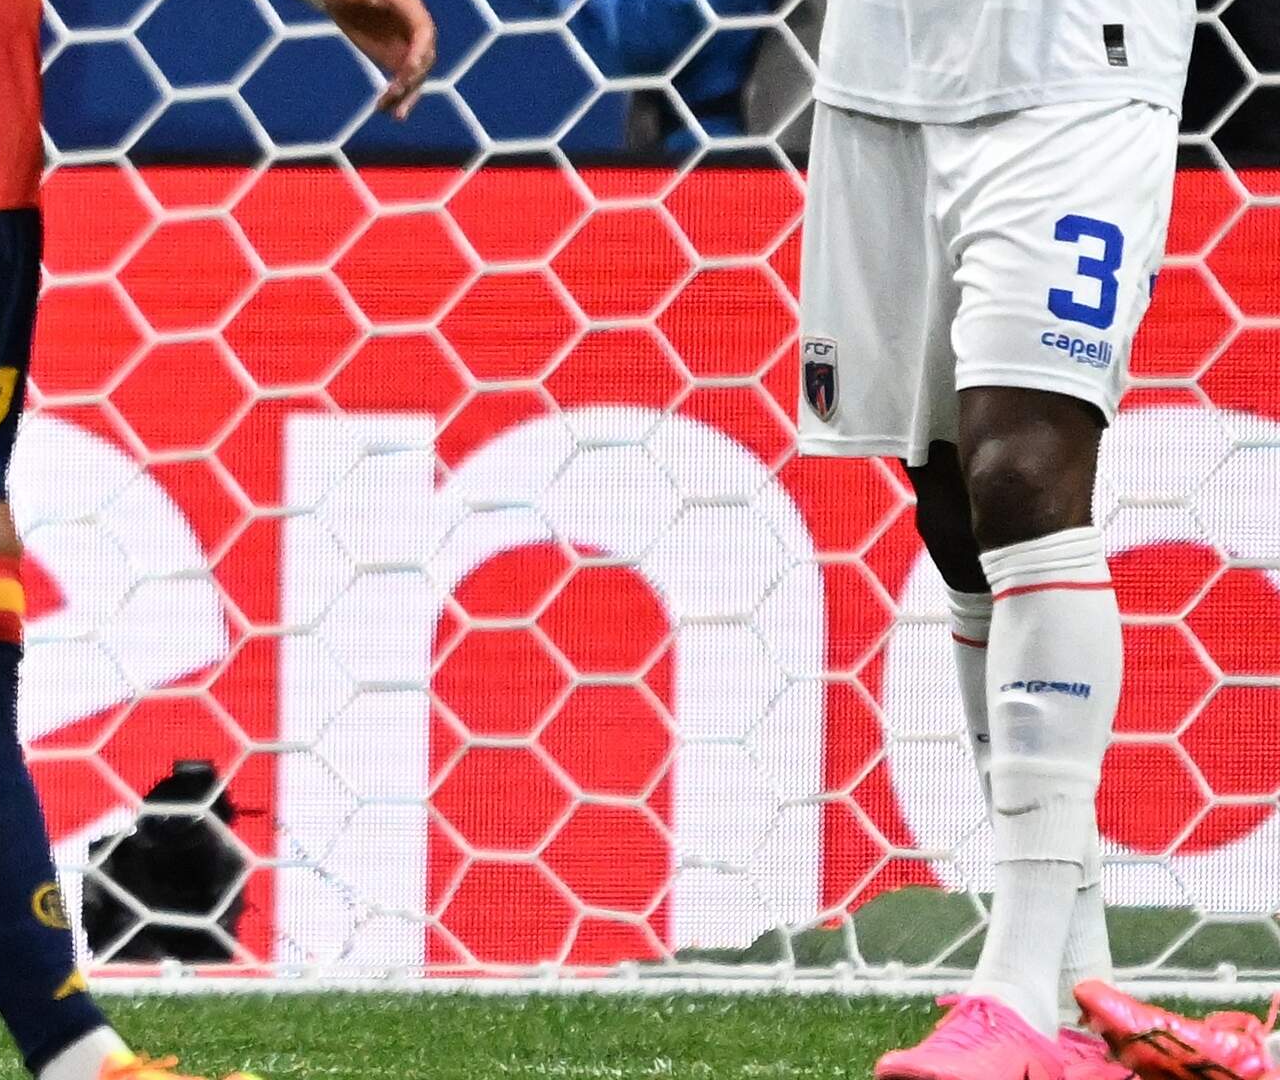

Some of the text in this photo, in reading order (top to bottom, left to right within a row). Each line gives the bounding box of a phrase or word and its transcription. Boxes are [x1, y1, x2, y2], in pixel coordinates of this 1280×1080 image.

[1048, 213, 1125, 330] 3
[805, 342, 834, 356] FCF
[1041, 332, 1114, 365] capelli
